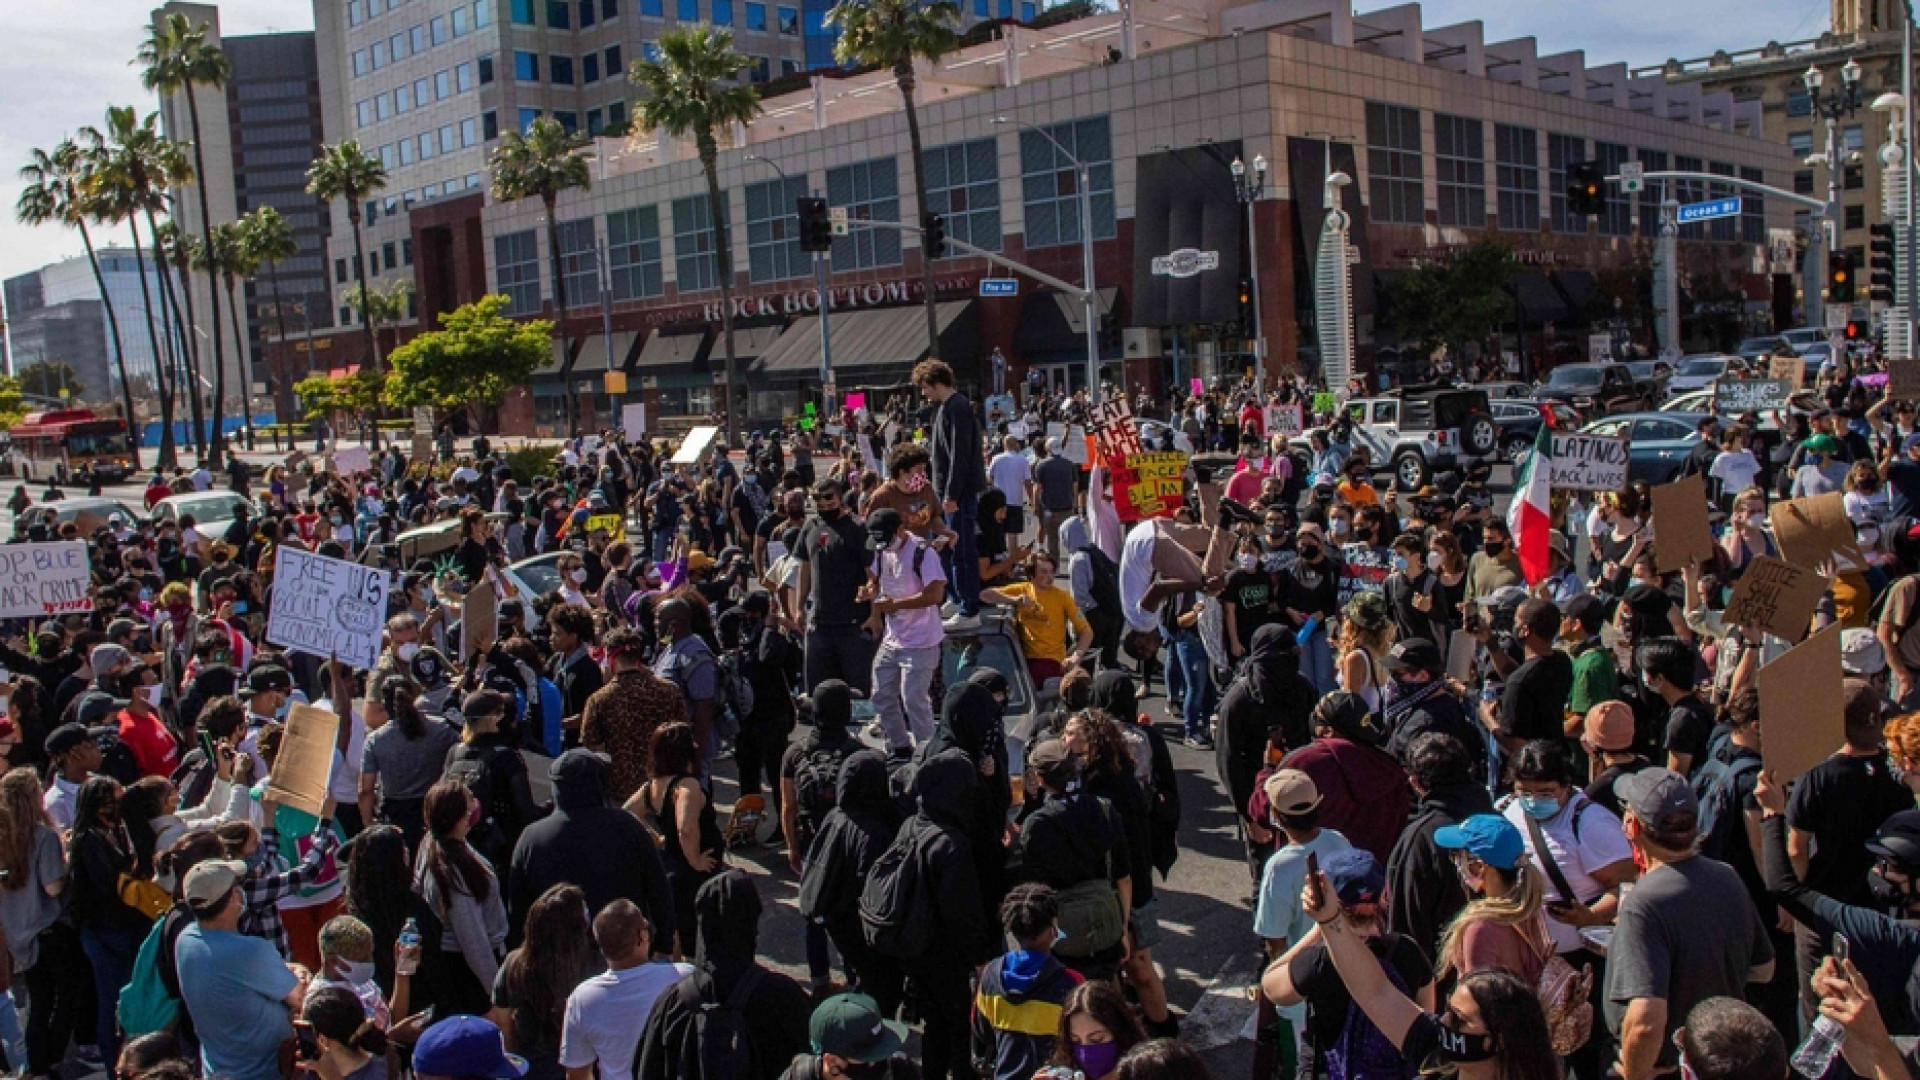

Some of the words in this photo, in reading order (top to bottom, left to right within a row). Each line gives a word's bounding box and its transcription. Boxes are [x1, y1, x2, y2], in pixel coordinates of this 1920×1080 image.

[1684, 205, 1718, 218] Ocean
[1094, 415, 1138, 447] THE
[1553, 438, 1630, 465] LATINOS
[1587, 471, 1624, 488] LIVES
[33, 548, 82, 570] BLUE
[281, 548, 338, 586] FREE
[1439, 1026, 1466, 1054] LM
